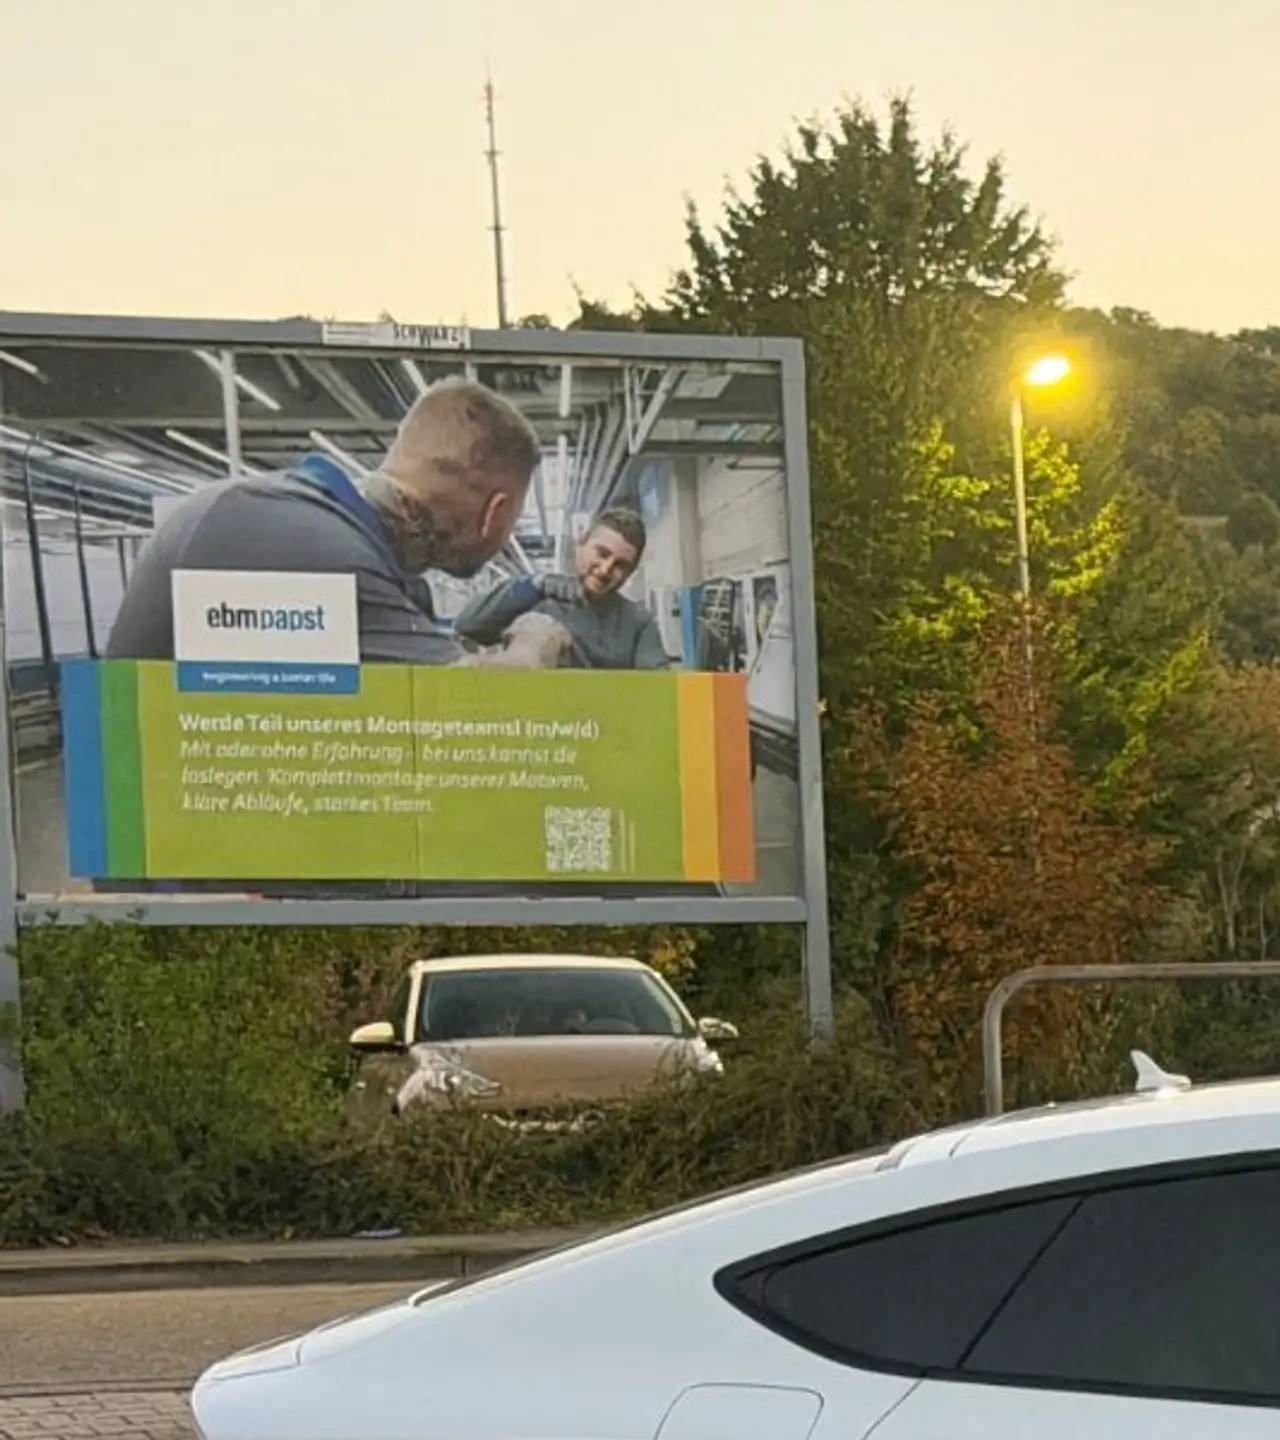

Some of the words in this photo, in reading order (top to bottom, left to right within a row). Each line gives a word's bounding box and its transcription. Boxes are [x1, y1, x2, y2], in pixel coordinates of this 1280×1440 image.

[207, 601, 325, 631] ebmpapst
[178, 713, 244, 731] Werde
[247, 714, 282, 732] Teil
[286, 716, 363, 734] unseres
[180, 740, 211, 757] Mit
